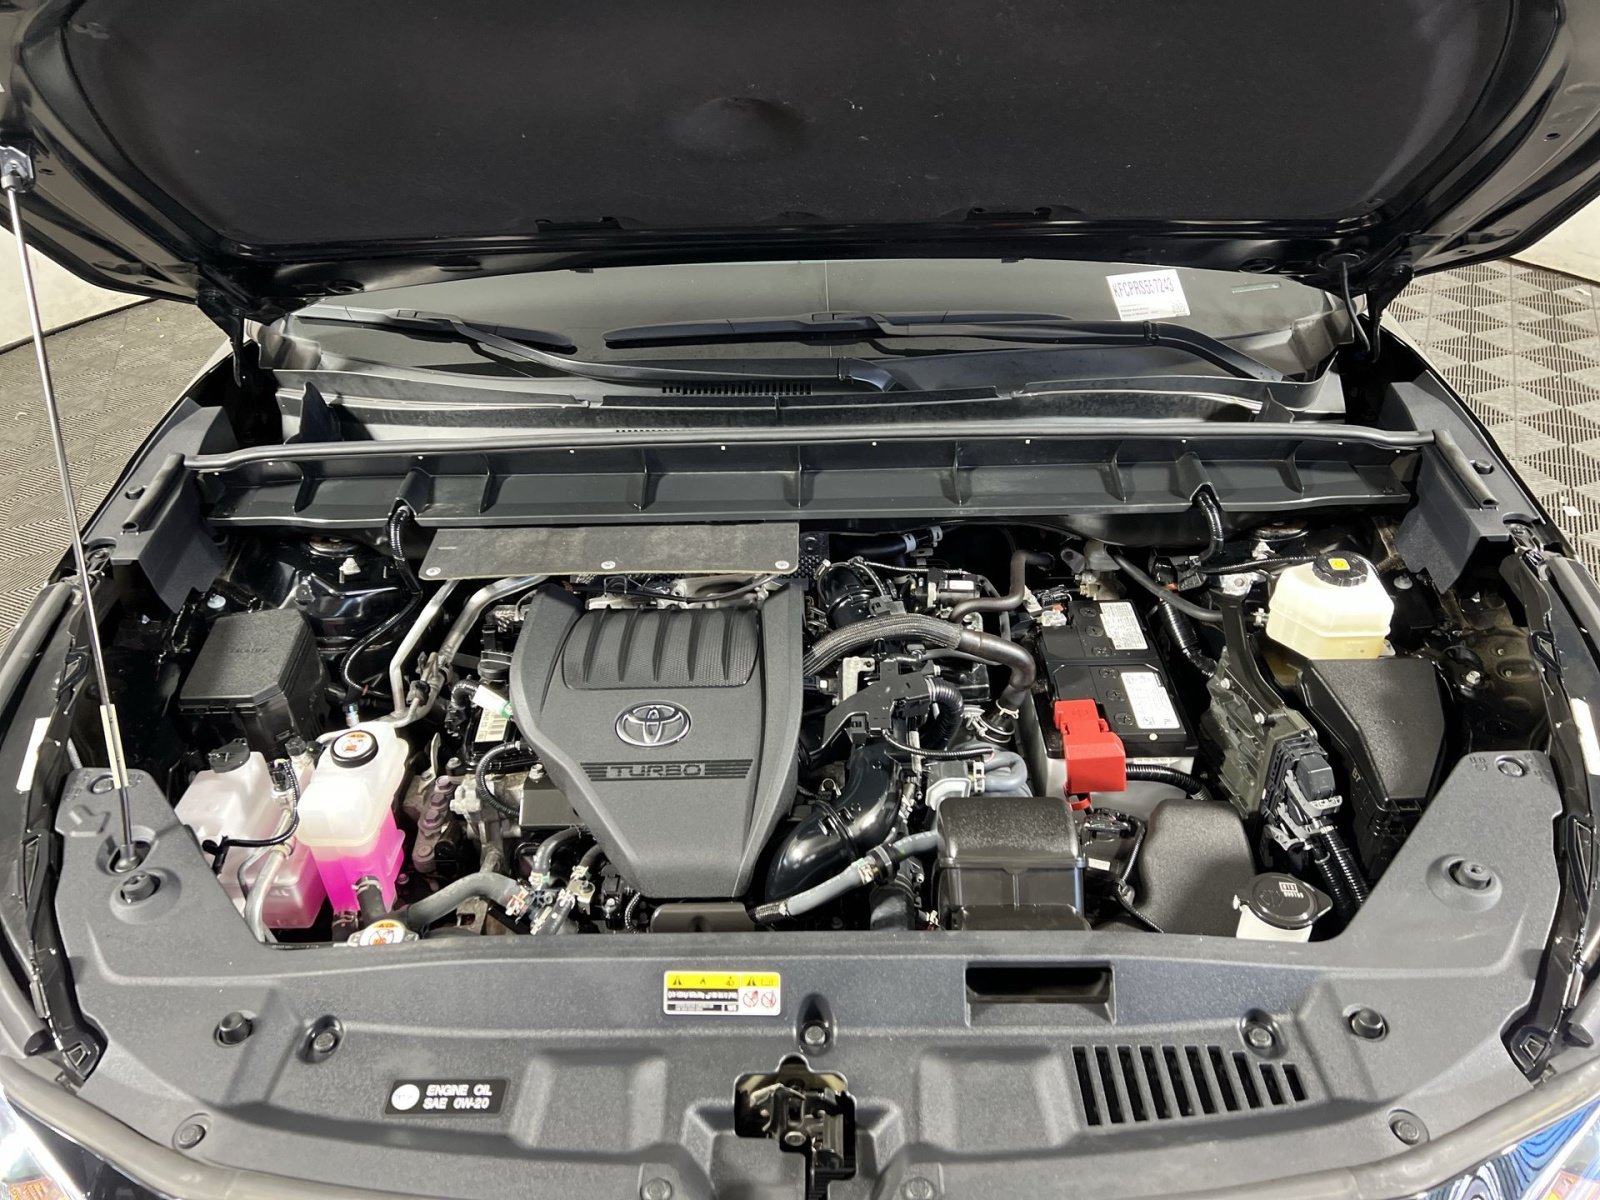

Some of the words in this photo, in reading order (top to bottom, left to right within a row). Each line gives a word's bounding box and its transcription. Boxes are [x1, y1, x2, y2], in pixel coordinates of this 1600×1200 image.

[610, 763, 703, 777] TURBO
[426, 1084, 469, 1096] ENGINE
[473, 1084, 493, 1096] OIL
[422, 1097, 448, 1109] SAE
[453, 1097, 490, 1109] 0W-20
